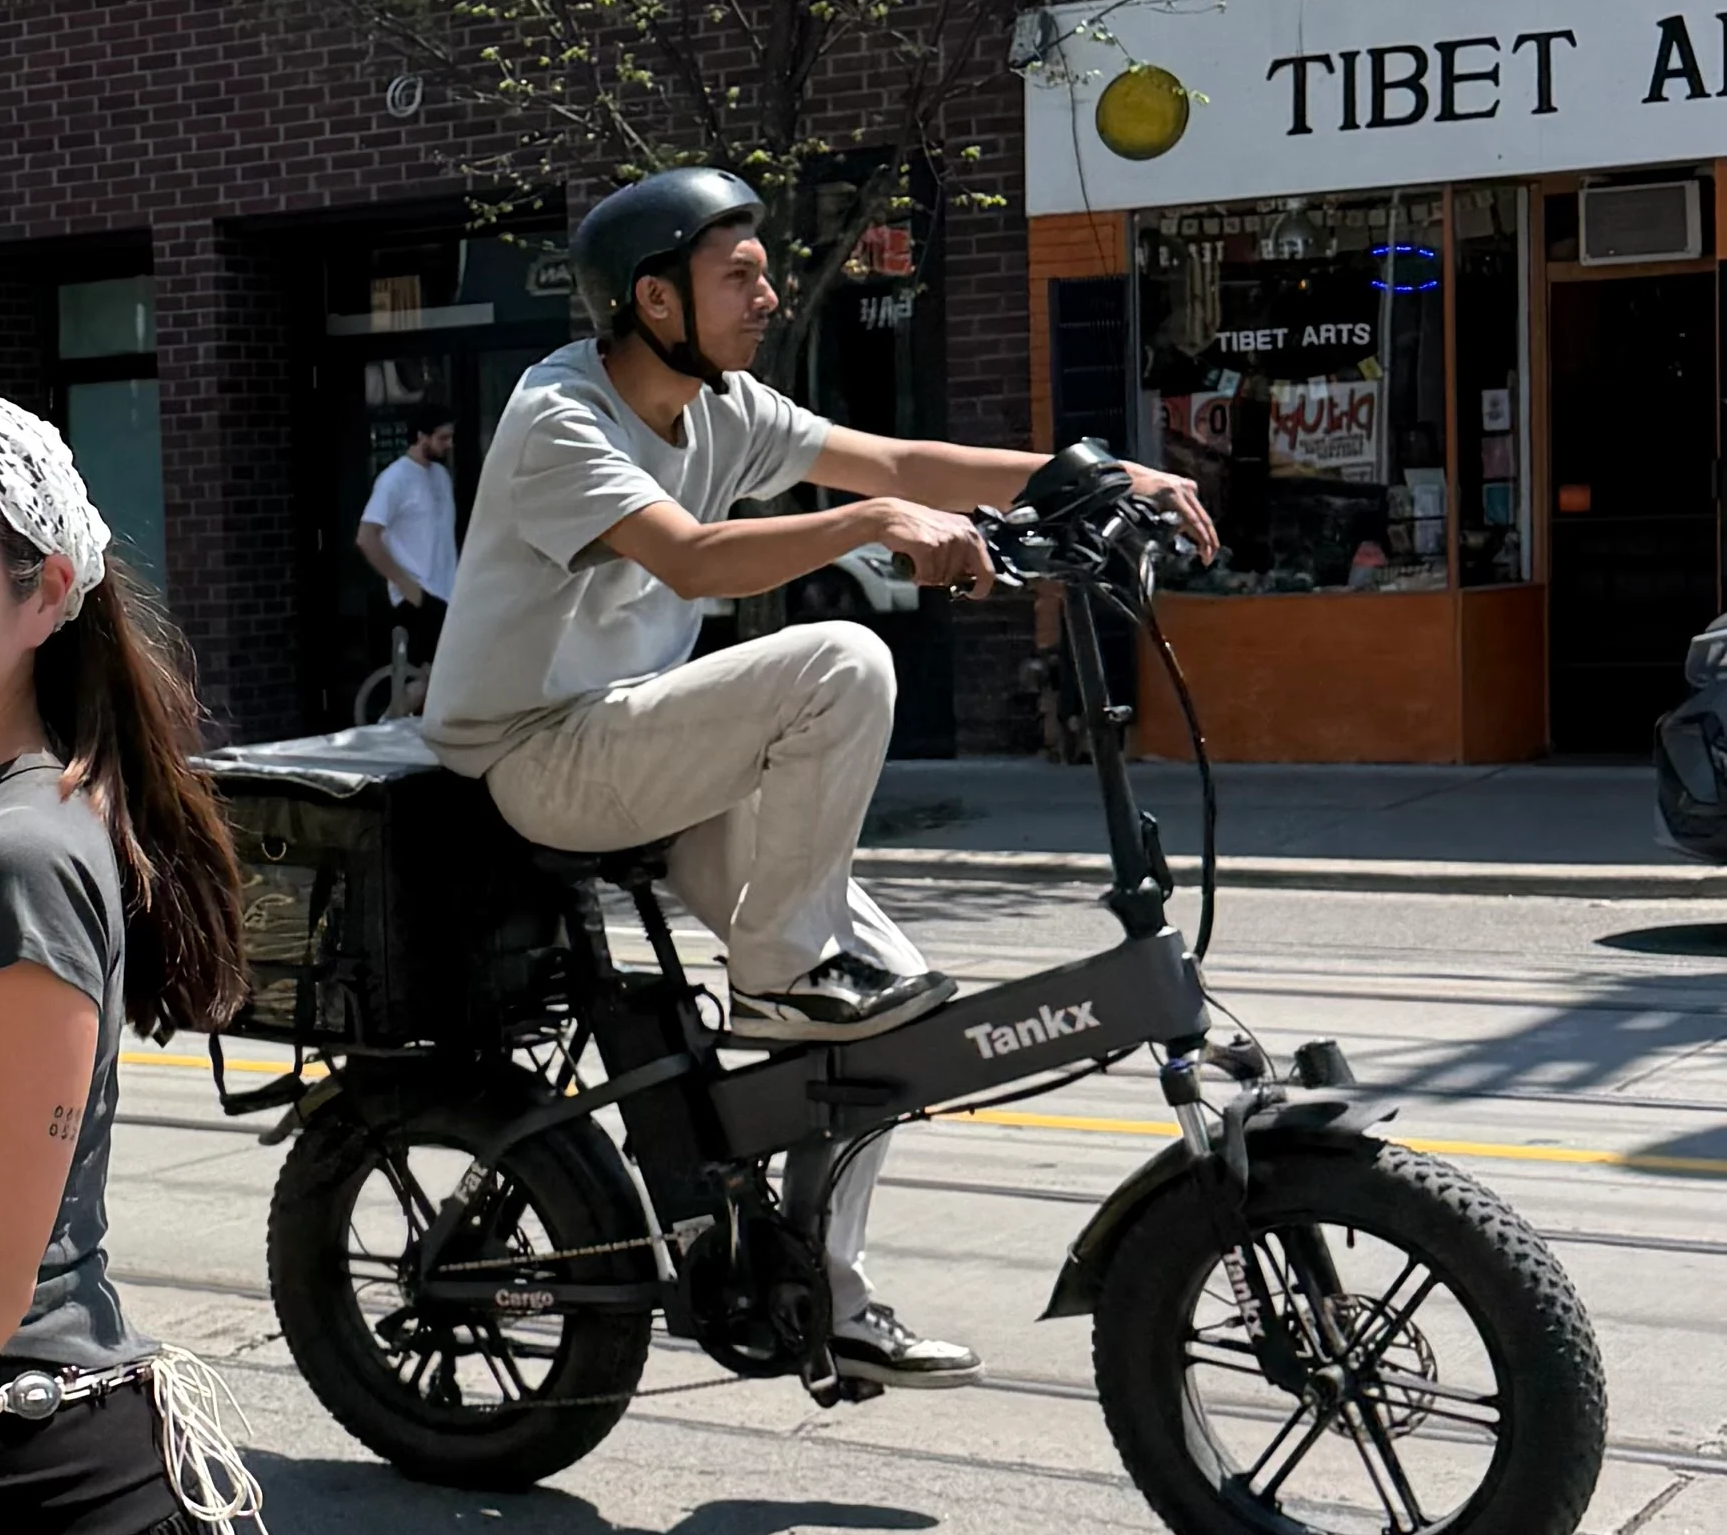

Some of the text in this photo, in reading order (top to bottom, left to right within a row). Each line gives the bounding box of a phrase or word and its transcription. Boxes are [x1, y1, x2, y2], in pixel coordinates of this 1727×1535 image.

[1266, 30, 1577, 136] TIBET
[1214, 323, 1371, 353] TIBET ARTS
[964, 1000, 1102, 1059] Tankx
[495, 1288, 554, 1309] Cargo
[1222, 1245, 1266, 1342] Tankx
